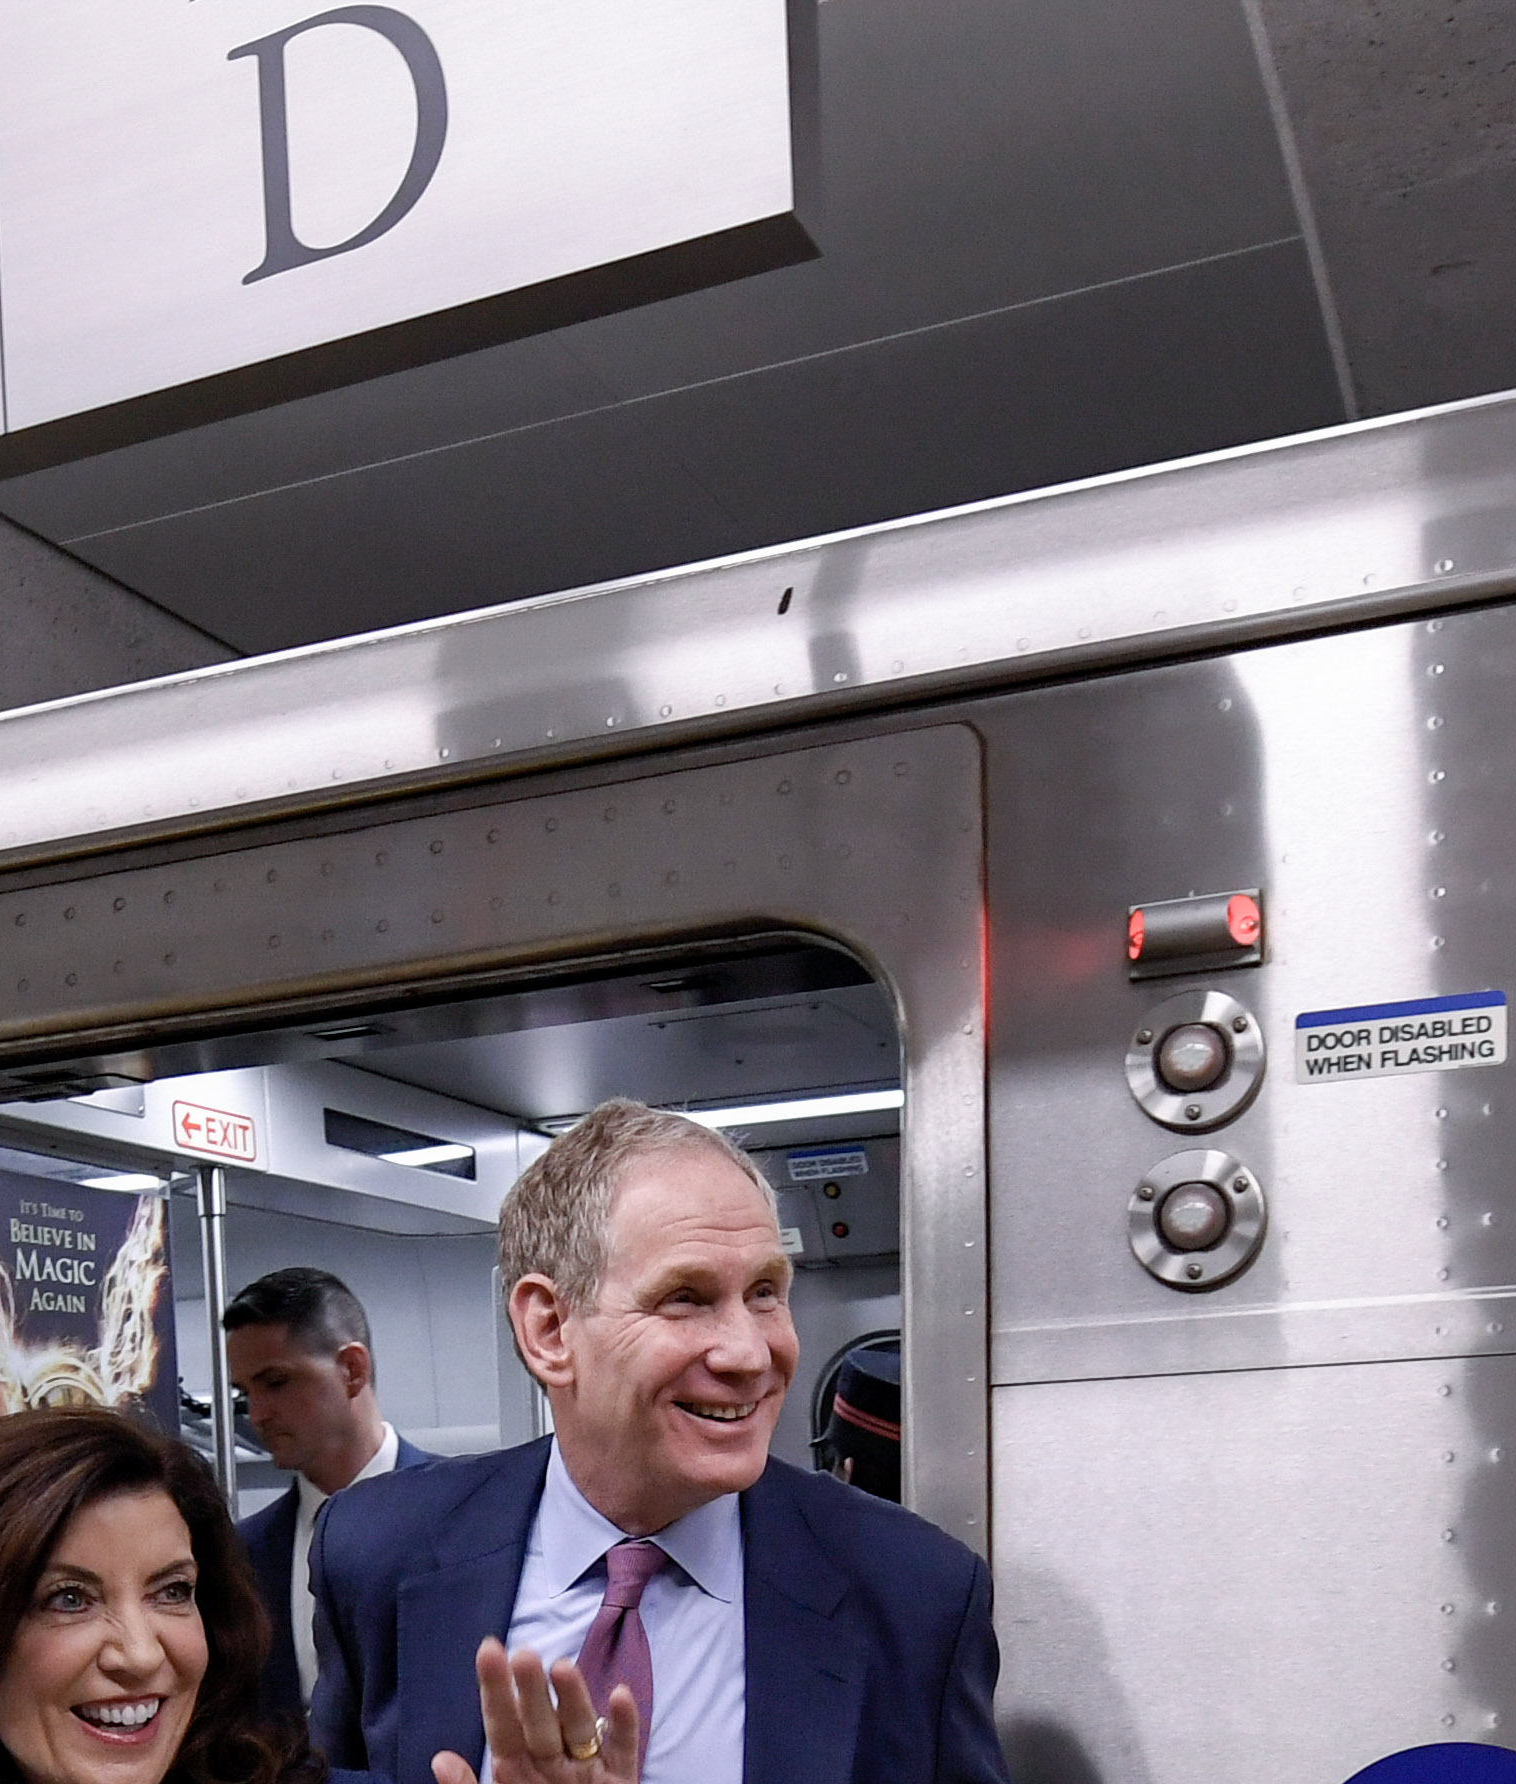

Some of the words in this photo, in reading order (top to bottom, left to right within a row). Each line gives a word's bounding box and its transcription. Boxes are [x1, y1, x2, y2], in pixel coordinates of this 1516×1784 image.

[226, 3, 450, 287] D
[1306, 1028, 1372, 1053] DOOR
[1378, 1014, 1493, 1045] DISABLED
[1305, 1052, 1373, 1077] WHEN
[1380, 1039, 1495, 1069] FLASHING
[205, 1116, 250, 1153] EXIT
[77, 1230, 97, 1252] IN
